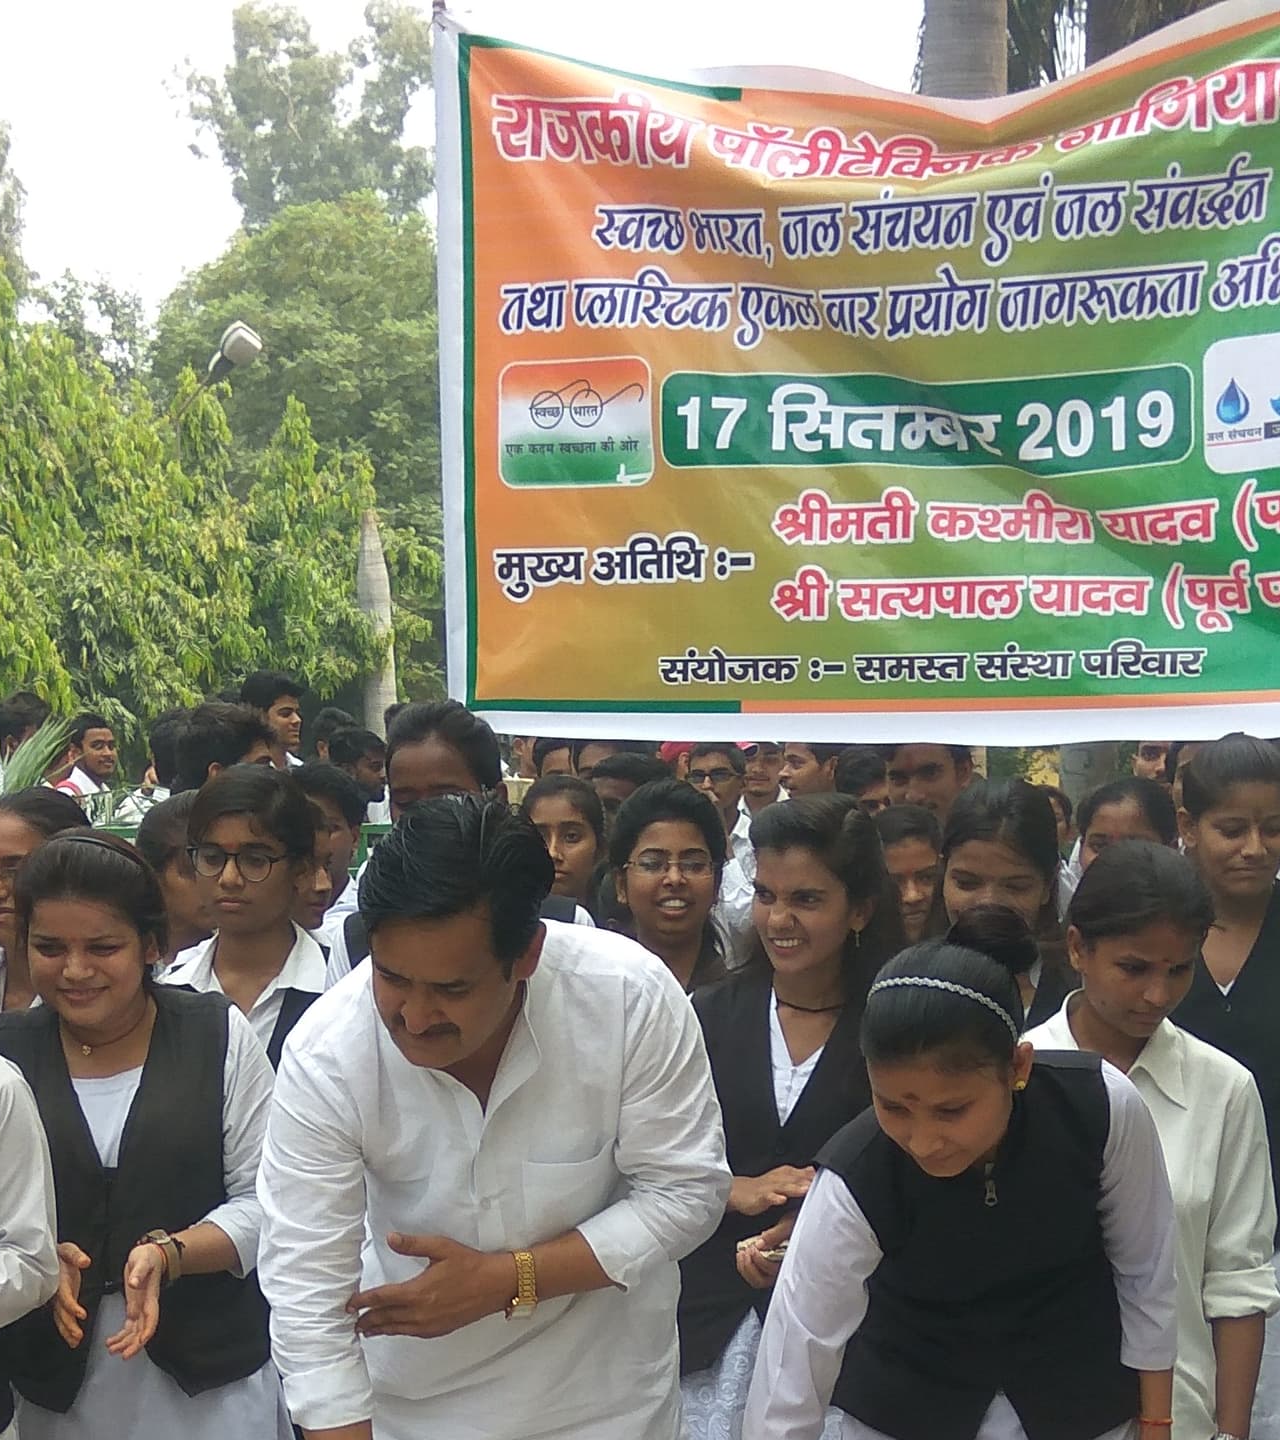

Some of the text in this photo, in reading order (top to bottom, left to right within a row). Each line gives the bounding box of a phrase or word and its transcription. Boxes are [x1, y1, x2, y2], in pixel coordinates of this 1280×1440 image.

[494, 93, 697, 165] राजकीय
[596, 207, 685, 249] स्वच्छ
[691, 209, 772, 263] भारत,
[780, 208, 841, 254] जल
[851, 188, 977, 250] संचयन
[984, 175, 1051, 262] एवं
[1056, 186, 1125, 237] जल
[502, 285, 566, 331] तथा
[575, 270, 732, 329] प्लास्टिक
[736, 286, 819, 346] एकल
[821, 291, 880, 336] वार
[888, 268, 990, 338] प्रयोग
[1001, 267, 1204, 329] जागरूकता
[573, 405, 598, 417] भारत
[677, 382, 1175, 461] 17 सितम्बर 2019
[774, 492, 916, 542] श्रीमती
[929, 494, 1092, 541] कश्मीरा
[1100, 502, 1216, 542] यादव
[495, 550, 585, 599] मुख्य
[594, 537, 705, 579] अतिथि
[774, 570, 829, 617] श्री
[840, 579, 1024, 618] सत्यपाल
[1031, 579, 1150, 615] यादव
[1163, 563, 1250, 629] (पूर्व
[660, 649, 797, 682] संयोजक
[856, 654, 969, 681] समस्त
[977, 644, 1071, 679] संस्था
[1082, 642, 1205, 678] परिवार
